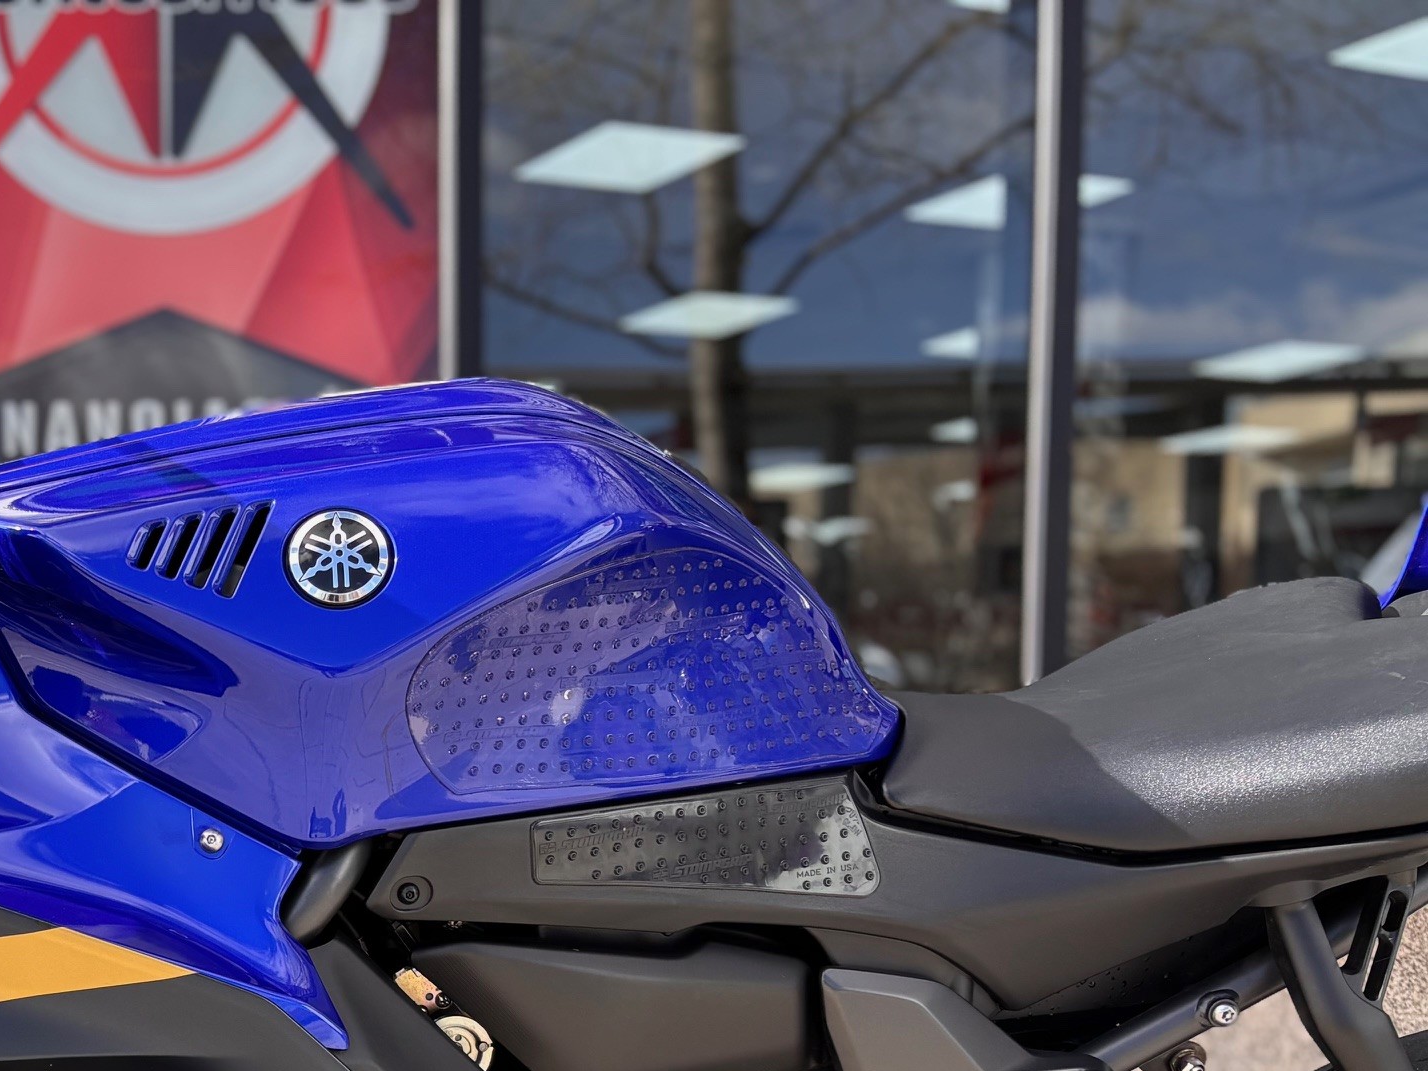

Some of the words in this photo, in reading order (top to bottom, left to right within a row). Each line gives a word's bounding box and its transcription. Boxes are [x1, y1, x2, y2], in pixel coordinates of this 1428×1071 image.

[796, 868, 822, 879] MADE
[826, 866, 836, 874] IN
[840, 863, 860, 872] USA
